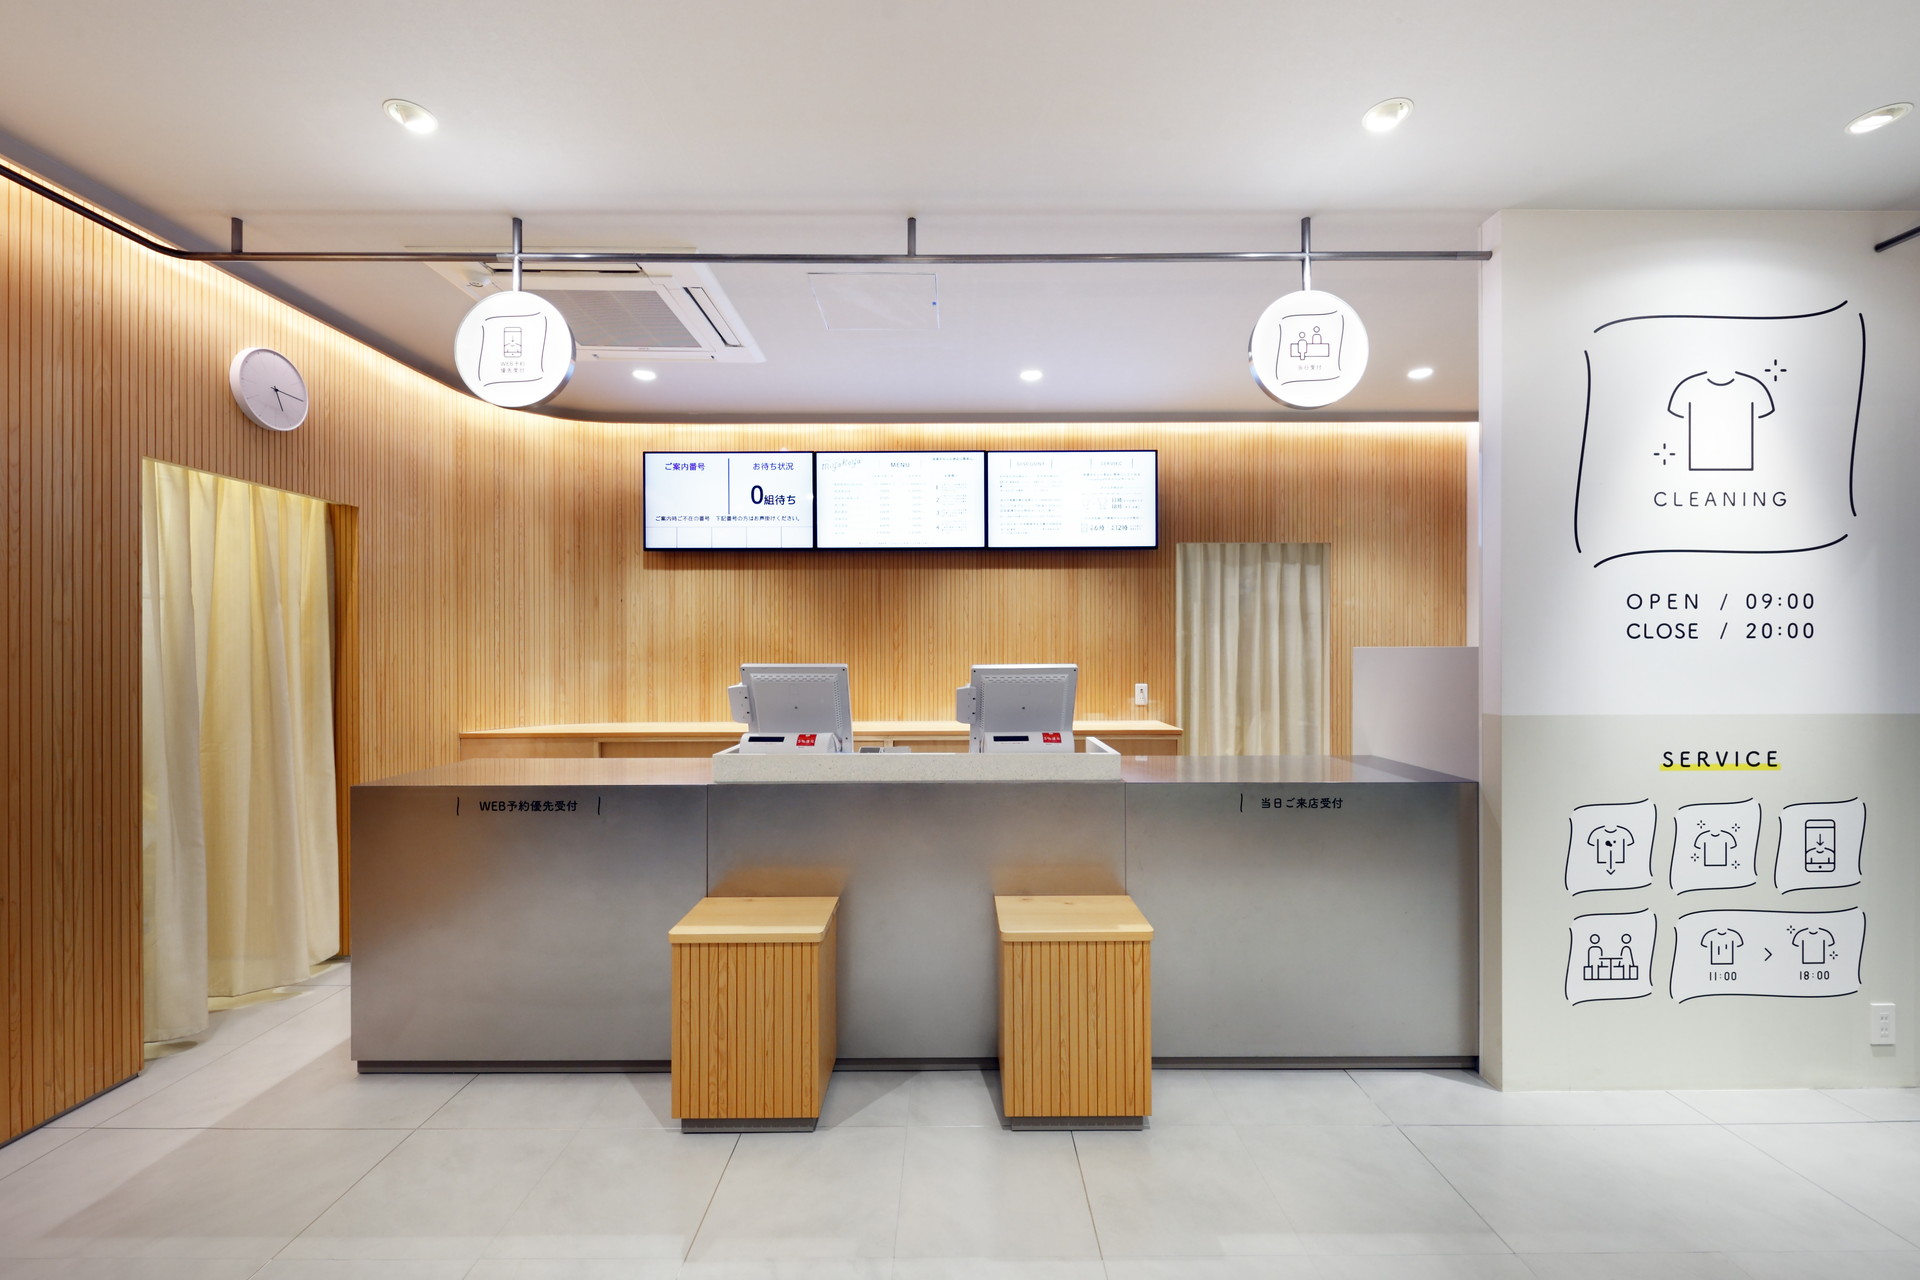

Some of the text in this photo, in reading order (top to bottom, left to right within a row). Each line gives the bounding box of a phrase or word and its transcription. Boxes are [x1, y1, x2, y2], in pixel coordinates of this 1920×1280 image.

[664, 462, 705, 471] ご案内番号
[752, 462, 795, 471] お待ち状況
[750, 484, 796, 506] 0組待ち
[1653, 491, 1787, 507] CLEANING
[1626, 593, 1698, 610] OPEN
[1745, 592, 1814, 610] 09:00
[1626, 622, 1699, 640] CLOSE
[1745, 622, 1815, 639] 20:00
[1663, 751, 1778, 767] SERVICE
[479, 800, 578, 812] WEB予約優先受付
[1261, 797, 1344, 809] 当日ご来店受付
[1709, 970, 1830, 982] 11:00 18:00
